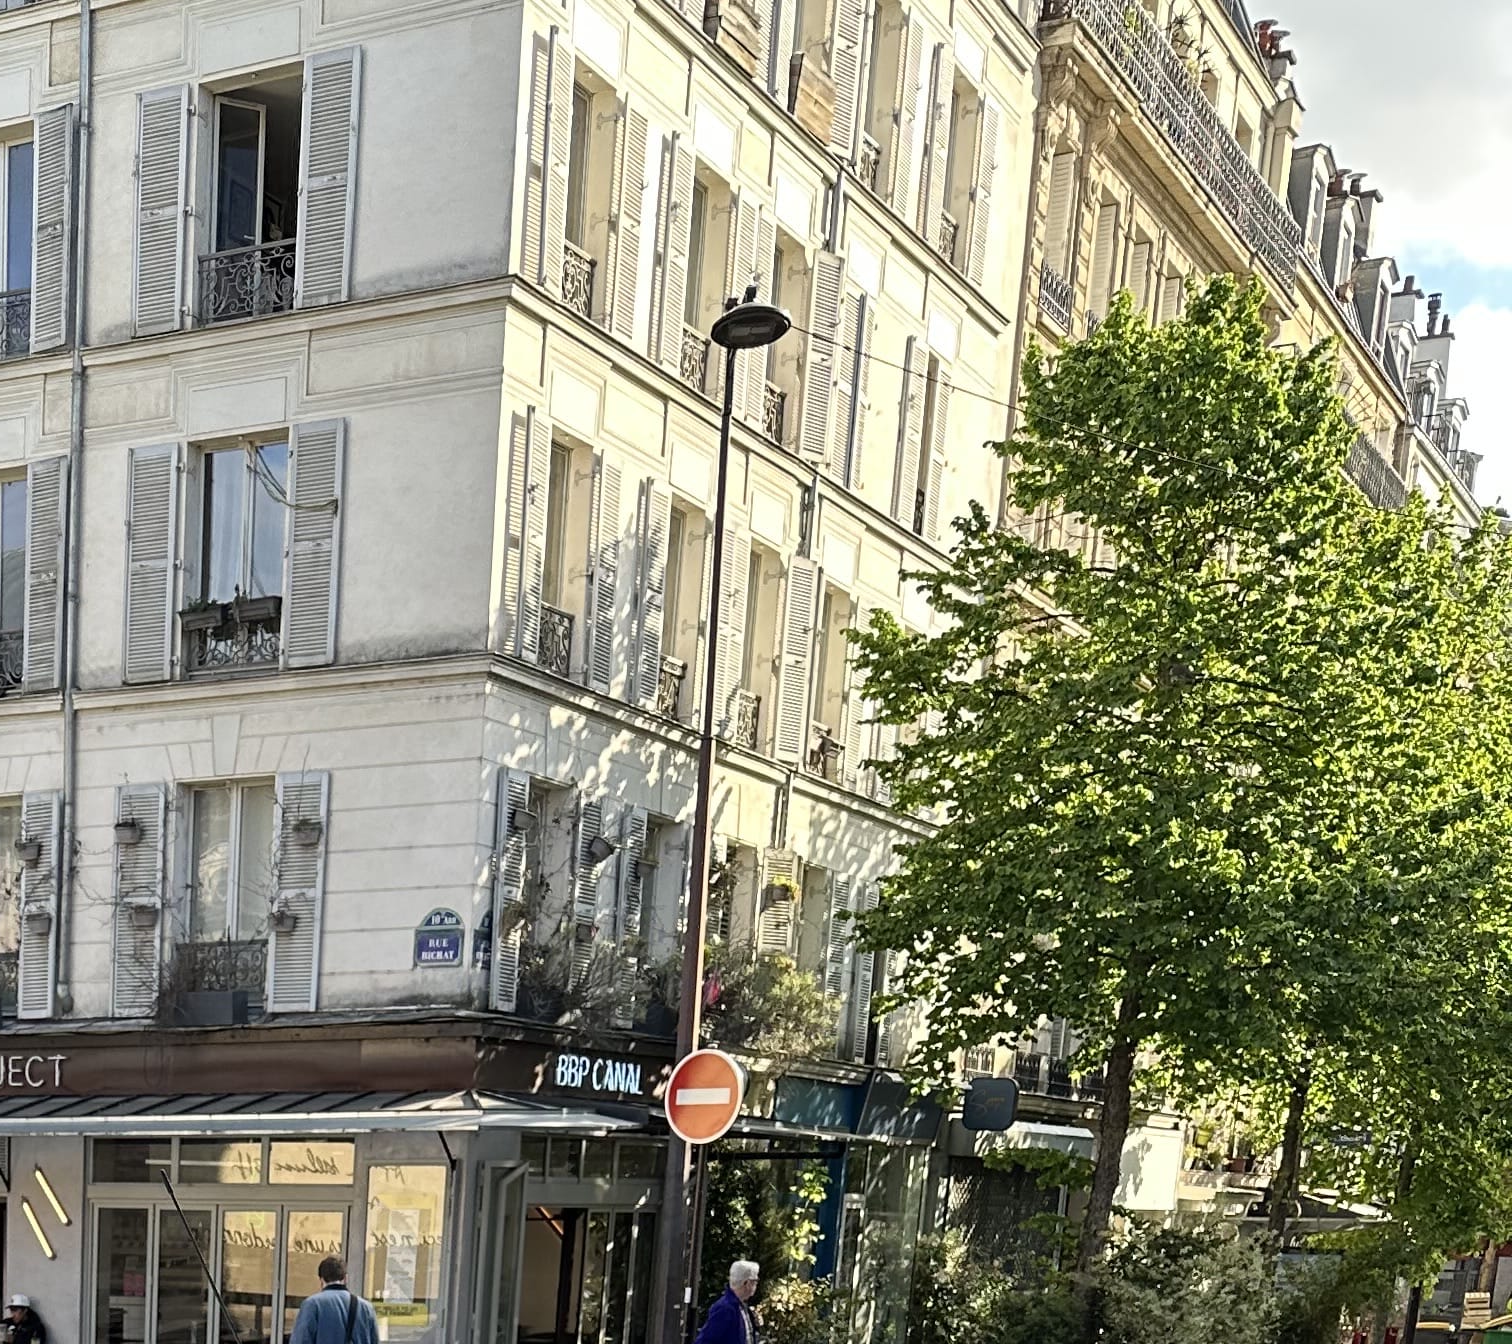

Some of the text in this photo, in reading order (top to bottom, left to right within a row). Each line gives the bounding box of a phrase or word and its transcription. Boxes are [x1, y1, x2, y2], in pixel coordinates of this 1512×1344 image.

[428, 938, 449, 948] RUE
[421, 950, 455, 960] BICHAT
[555, 1054, 644, 1095] BBP CANAL
